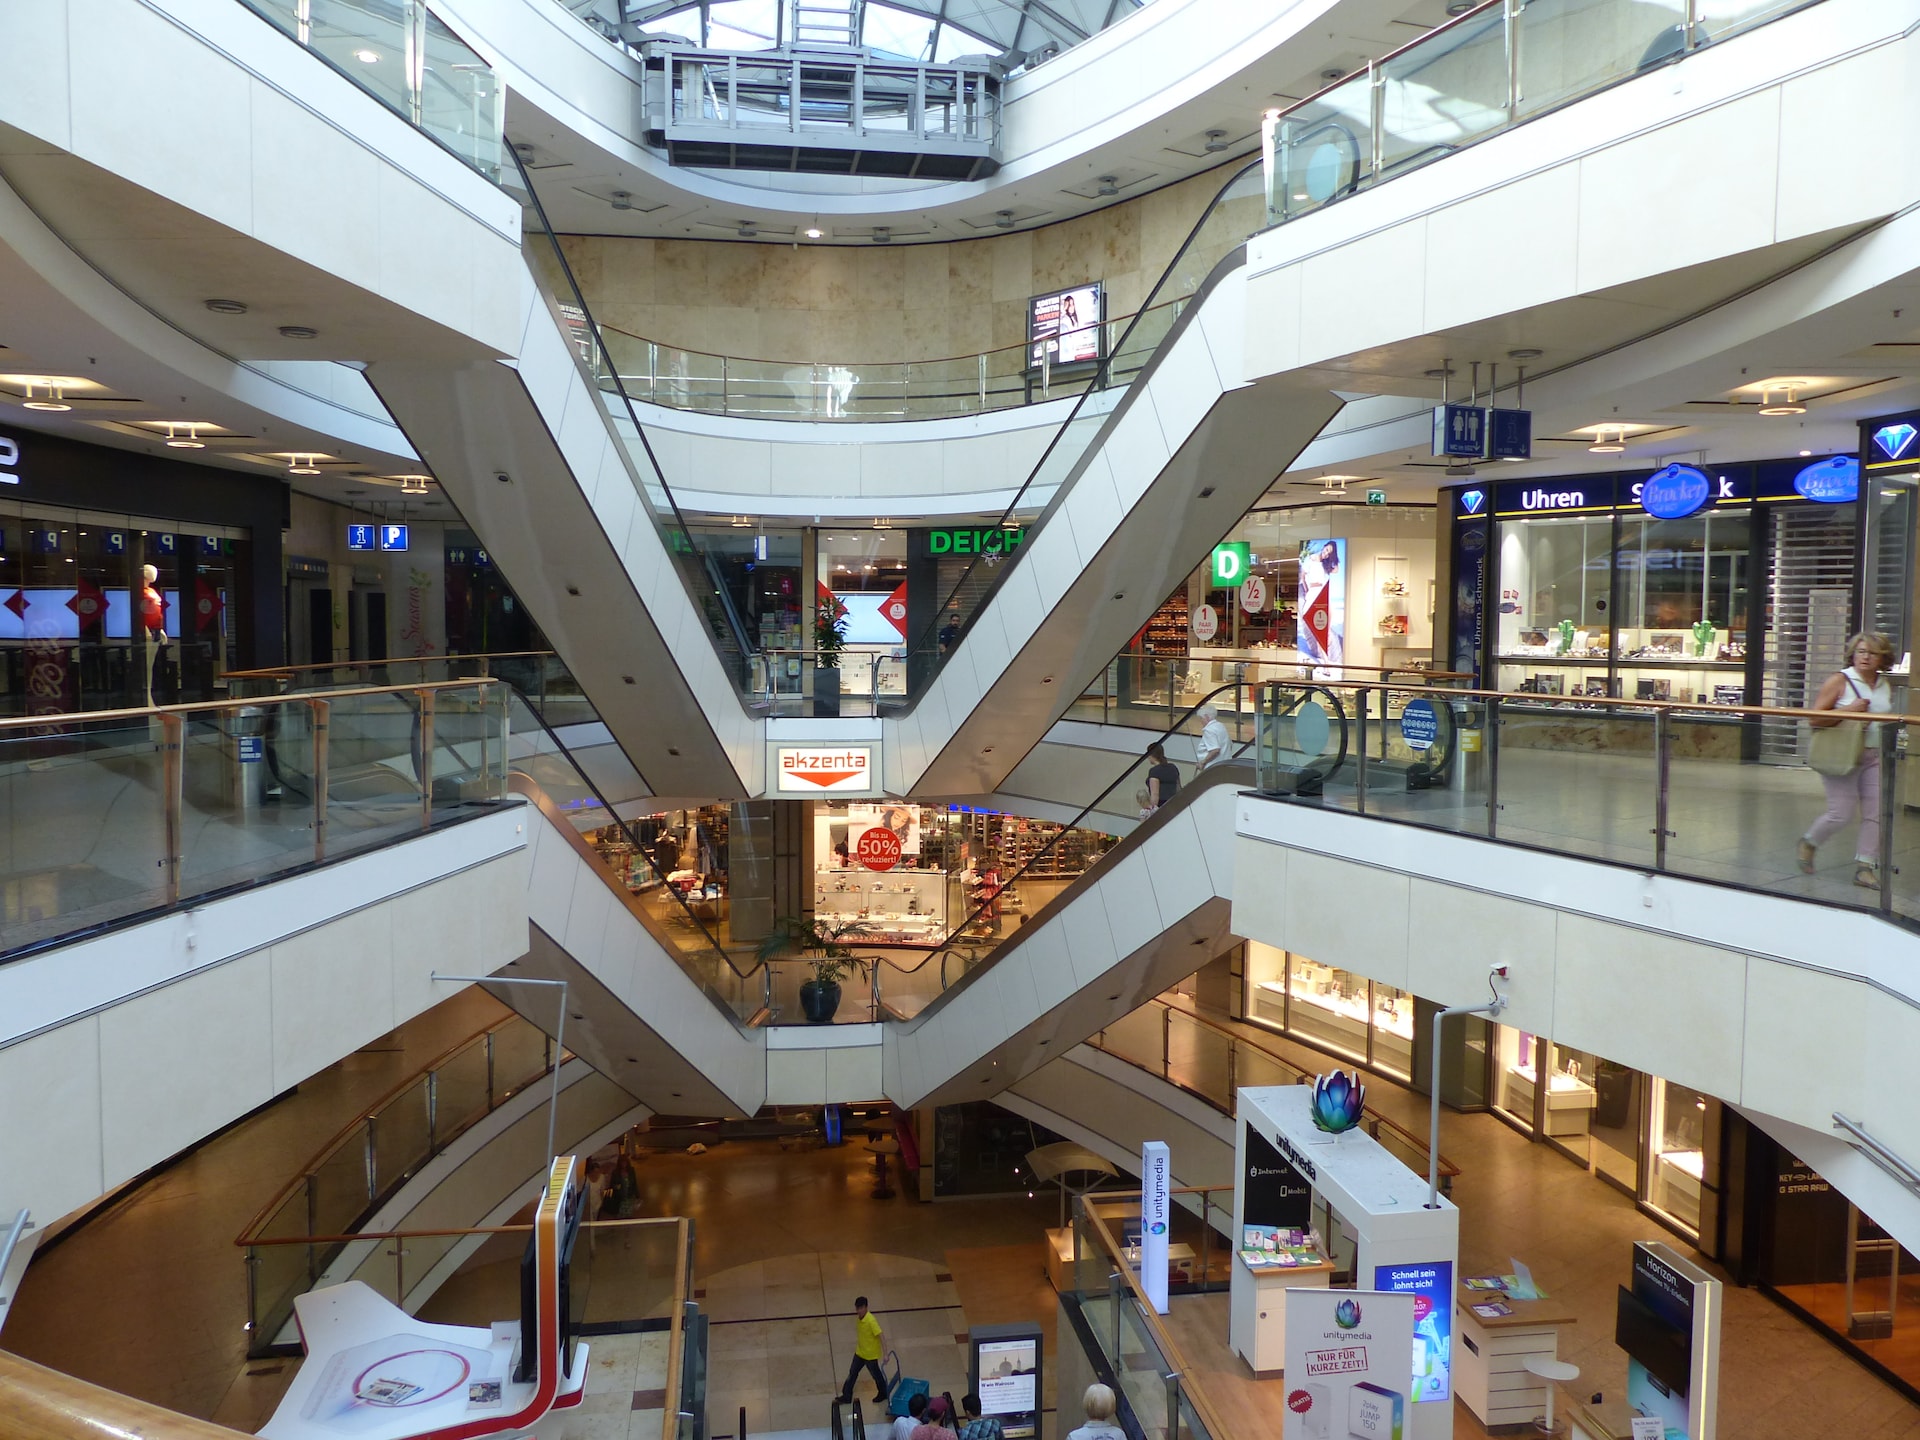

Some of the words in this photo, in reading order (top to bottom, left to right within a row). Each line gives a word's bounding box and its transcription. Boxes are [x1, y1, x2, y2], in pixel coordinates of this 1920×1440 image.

[1522, 489, 1584, 509] Uhren
[1218, 551, 1240, 579] D
[1476, 558, 1484, 604] Schmuck
[1201, 608, 1207, 620] 1
[1474, 613, 1482, 645] Uhren
[784, 752, 865, 768] akzenta
[859, 840, 899, 855] 50%
[862, 856, 897, 864] reduziert!
[1276, 1133, 1316, 1182] unitymedia
[1258, 1167, 1288, 1175] Internet
[1779, 1174, 1793, 1182] KEY
[1154, 1157, 1166, 1218] unitymedia
[1788, 1185, 1809, 1193] STAR
[1810, 1184, 1829, 1192] RAW
[1392, 1270, 1419, 1280] Schnell
[1646, 1256, 1677, 1286] Horizon
[1394, 1281, 1414, 1290] lohnt
[1415, 1280, 1433, 1288] sich!
[1323, 1331, 1372, 1341] unitymedia
[1317, 1352, 1336, 1362] NUR
[1338, 1350, 1355, 1360] FÜR
[1310, 1361, 1339, 1373] KURZE
[1342, 1360, 1364, 1370] ZEIT!
[1290, 1395, 1311, 1409] GRATIS
[1363, 1400, 1379, 1412] 2play
[1360, 1409, 1381, 1422] JUMP
[1362, 1419, 1376, 1431] 150
